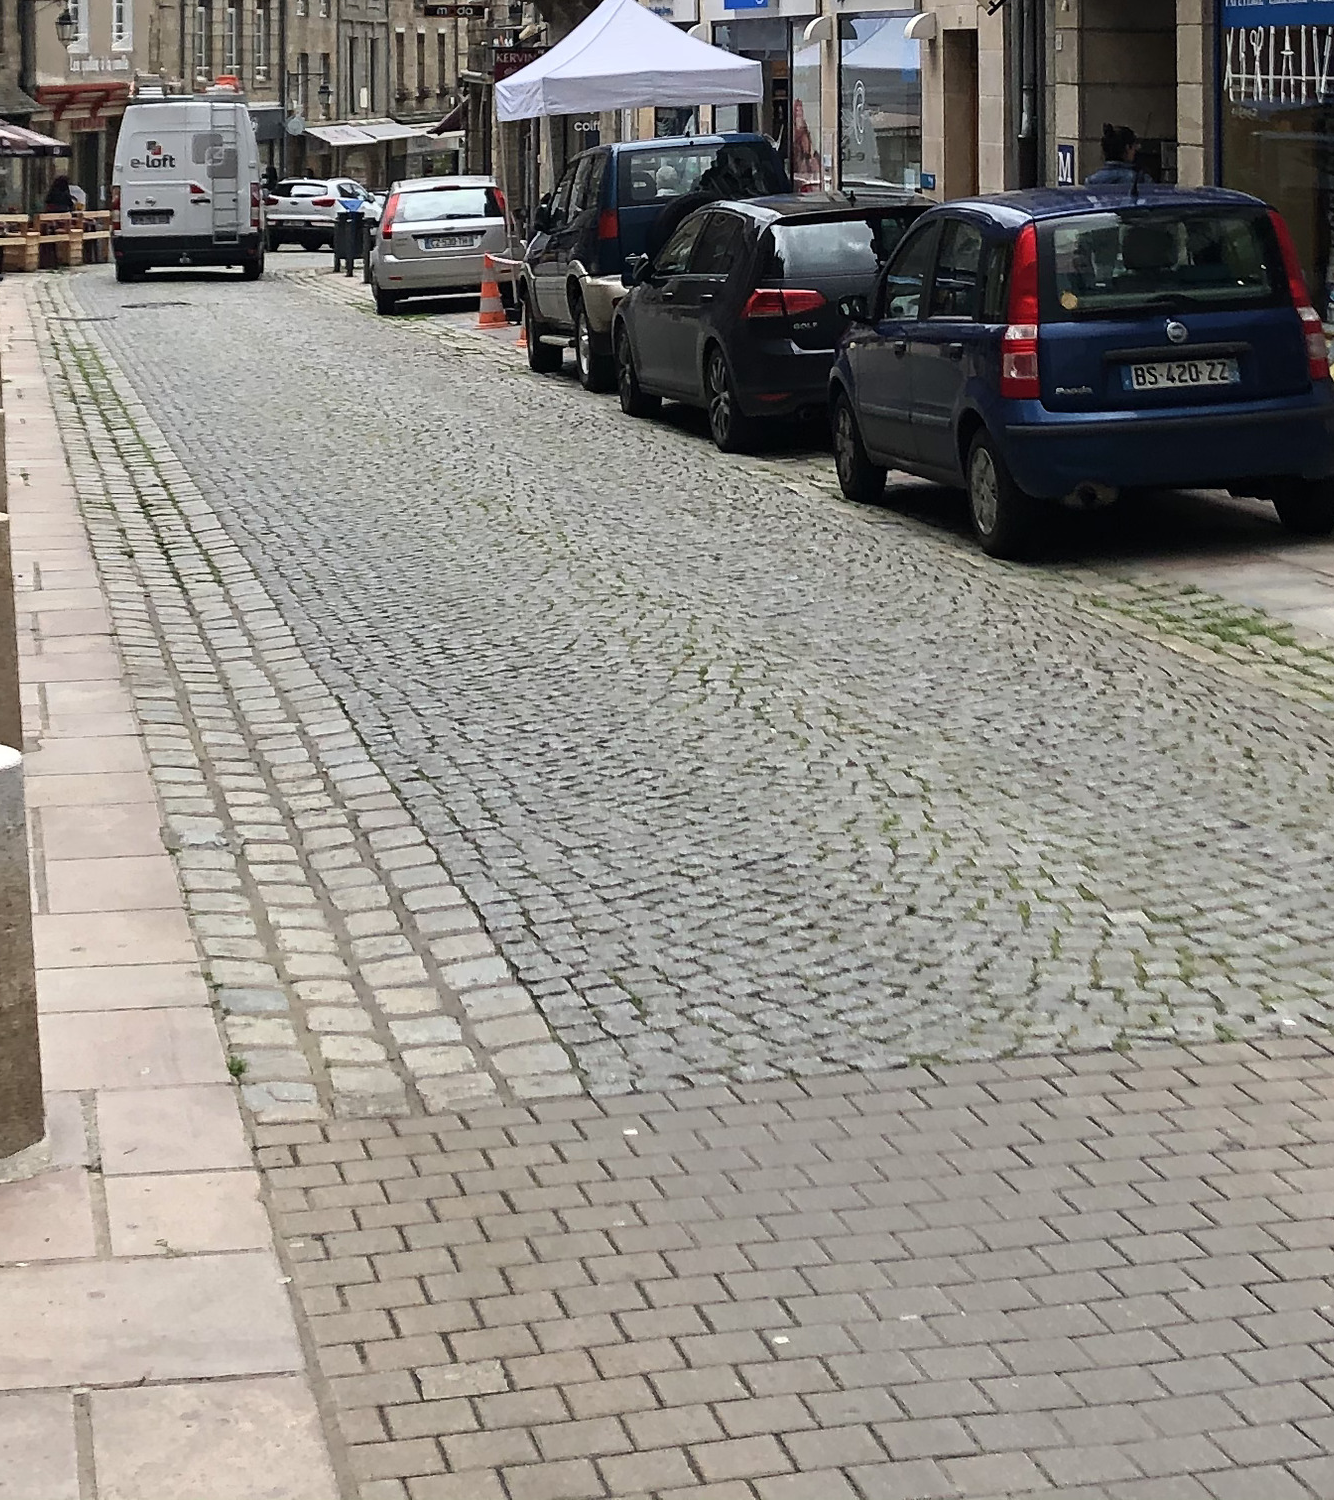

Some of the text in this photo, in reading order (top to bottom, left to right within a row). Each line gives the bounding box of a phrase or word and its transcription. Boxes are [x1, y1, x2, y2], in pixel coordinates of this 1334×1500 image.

[130, 154, 176, 168] e-loft
[1057, 151, 1072, 183] M
[1133, 361, 1229, 387] BS-420-ZZ
